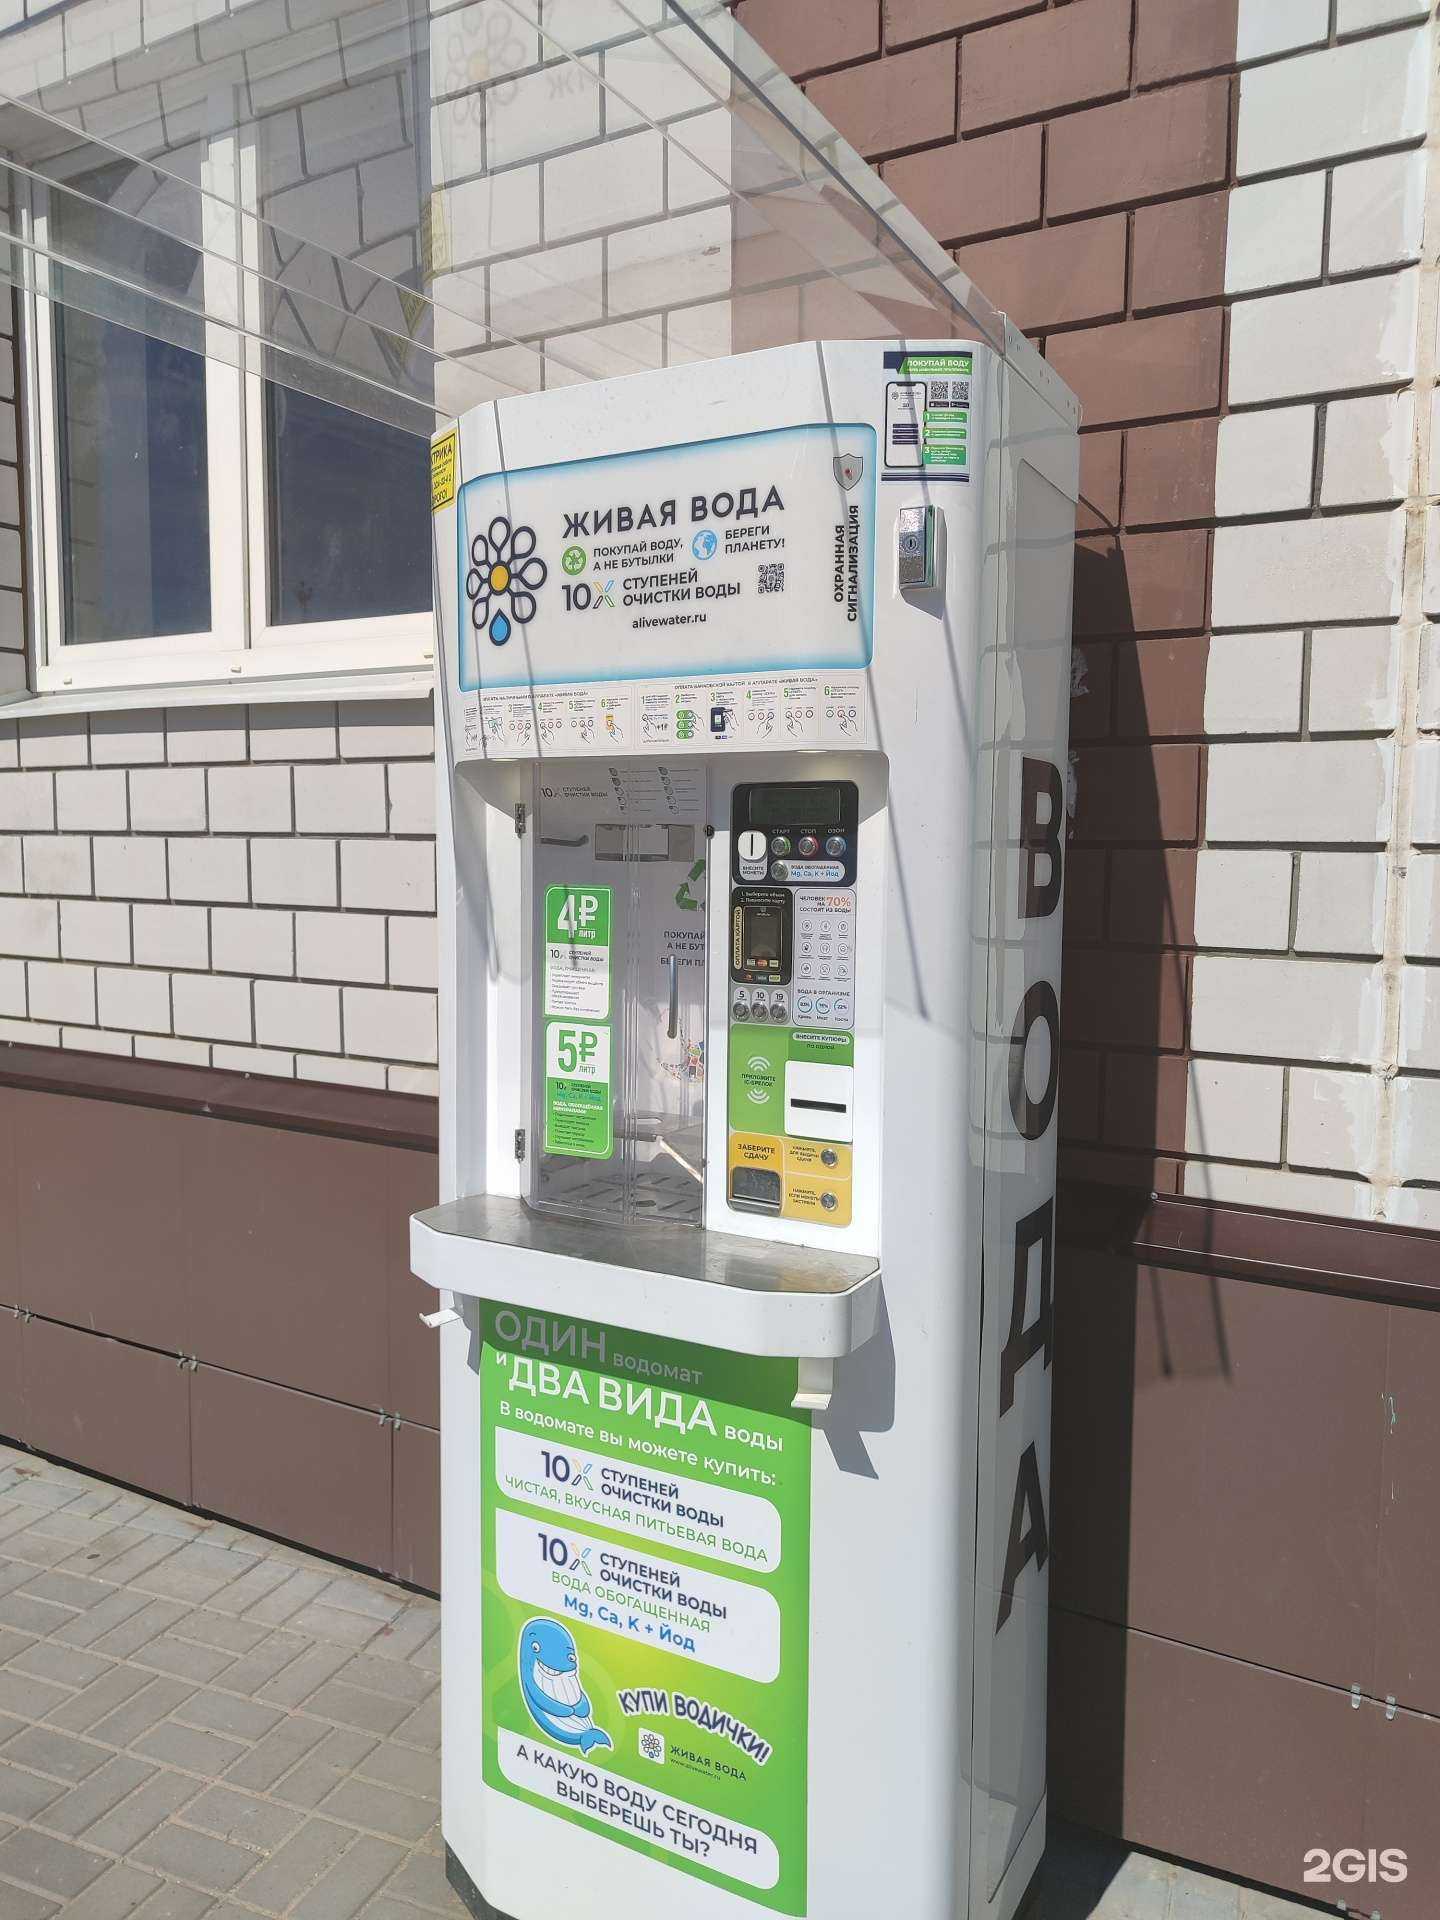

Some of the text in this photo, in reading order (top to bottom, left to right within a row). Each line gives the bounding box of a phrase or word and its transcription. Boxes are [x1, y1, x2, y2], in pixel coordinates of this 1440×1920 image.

[562, 485, 785, 539] ЖИВАЯ ВОДА
[593, 538, 683, 558] ПОКУПАЙ ВОДУ,
[725, 525, 770, 540] БЕРЕГИ
[725, 538, 785, 554] ПЛАНЕТУ!
[593, 553, 674, 571] А НЕ БУТЫЛКИ
[623, 568, 698, 590] СТУПЕНЕЙ
[834, 525, 844, 603] ОХРАННАЯ
[848, 506, 860, 622] СИГНАЛИЗАЦИЯ
[623, 582, 741, 606] ОЧИСТКИ ВОДЫ
[632, 613, 707, 629] alivewater.ru
[826, 870, 839, 878] Йод
[826, 895, 851, 907] 70%
[579, 929, 596, 939] литр
[756, 991, 764, 999] 10
[579, 1065, 595, 1075] литр
[741, 1073, 776, 1082] ПРИЛОЖИТЕ
[737, 1143, 775, 1154] ЗАБЕРИТЕ
[744, 1152, 769, 1161] СДАЧУ
[994, 756, 1063, 1637] ВОДА
[494, 1310, 703, 1385] ОДИН водомат
[509, 1354, 591, 1405] ДВА
[599, 1376, 718, 1437] ВИДА
[724, 1424, 783, 1453] воды
[500, 1401, 777, 1486] В водомате вы можете купить:
[600, 1467, 679, 1499] СТУПЕНЕЙ
[505, 1473, 767, 1561] ЧИСТАЯ, ВКУСНАЯ ПИТЬЕВАЯ ВОДА
[601, 1484, 724, 1528] ОЧИСТКИ ВОДЫ
[600, 1552, 681, 1588] СТУПЕНЕЙ
[552, 1571, 711, 1633] ВОДА ОБОГАЩЕННАЯ
[600, 1569, 727, 1620] ОЧИСТКИ ВОДЫ
[564, 1594, 593, 1619] Mg,
[597, 1606, 623, 1629] Ca,
[645, 1624, 654, 1634] +
[659, 1623, 697, 1653] Йод
[619, 1690, 770, 1762] КУПИ ВОДИЧКИ!
[670, 1745, 747, 1781] ЖИВАЯ ВОДА
[516, 1744, 757, 1855] А КАКУЮ ВОДУ СЕГОДНЯ
[556, 1780, 710, 1857] ВЫБЕРЕШЬ ТЫ?
